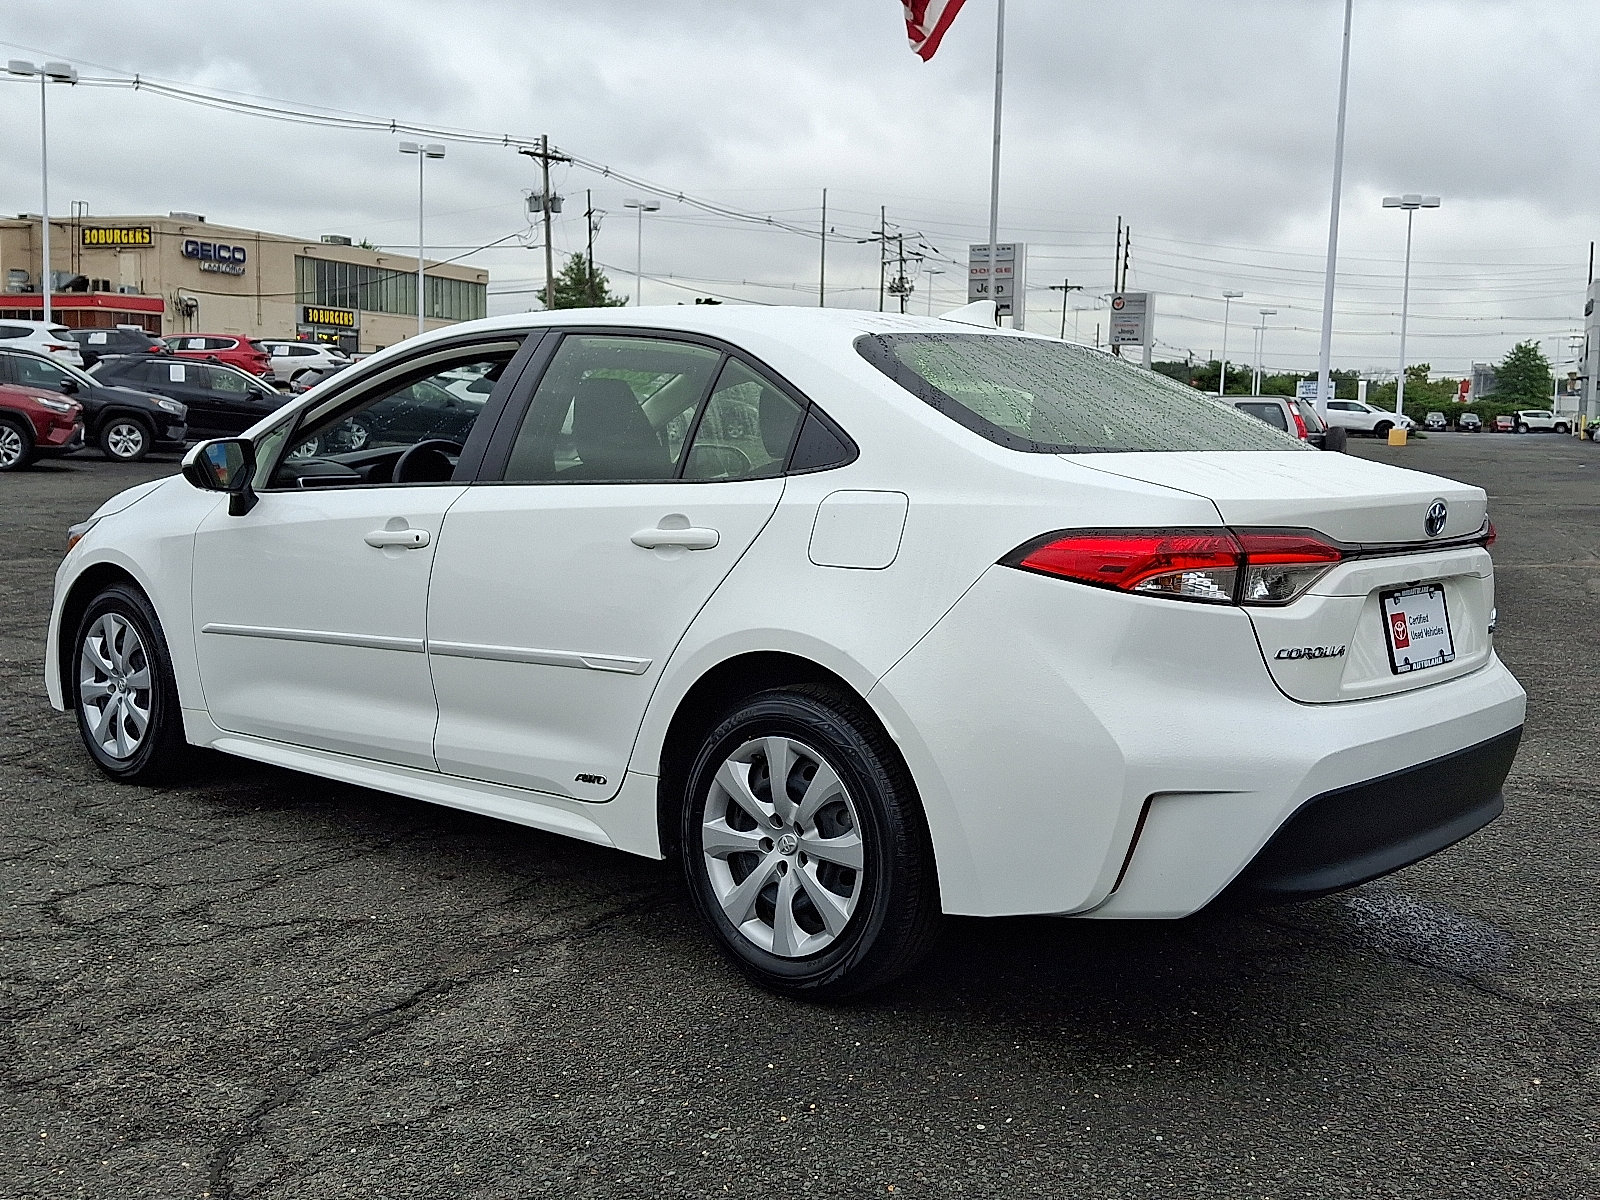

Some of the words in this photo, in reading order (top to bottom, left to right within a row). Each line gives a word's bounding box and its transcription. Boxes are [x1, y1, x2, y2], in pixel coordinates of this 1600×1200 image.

[183, 239, 247, 264] GEICO
[976, 283, 1004, 294] Jep
[319, 309, 353, 326] BURGERS
[1408, 613, 1430, 626] Certified
[1410, 629, 1424, 641] Used
[1424, 625, 1444, 638] Vehicles
[1274, 644, 1346, 660] COROLLA
[574, 773, 608, 785] AWD
